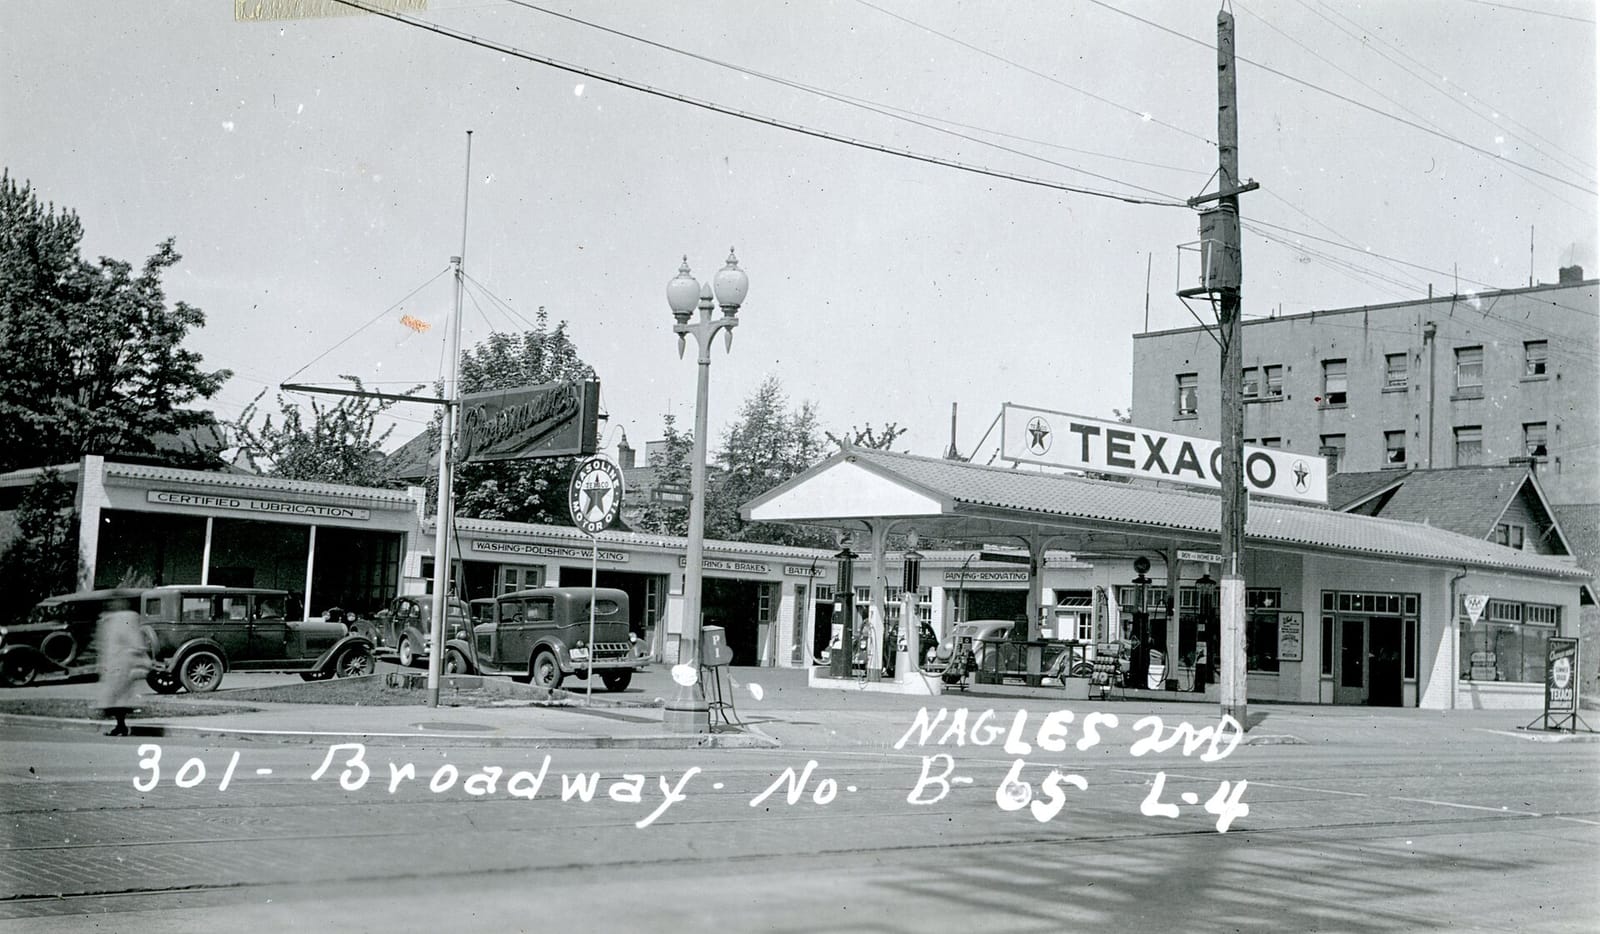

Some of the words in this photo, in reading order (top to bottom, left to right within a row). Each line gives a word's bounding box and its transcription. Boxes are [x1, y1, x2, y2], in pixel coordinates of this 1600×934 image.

[575, 460, 620, 489] GASOLINE
[157, 493, 241, 508] CERTIFIED
[250, 501, 354, 517] LUBRICATION
[572, 501, 603, 532] MOTOR
[605, 500, 619, 523] OIL
[681, 558, 723, 569] RIRING
[734, 562, 766, 572] BRAKES
[1550, 688, 1573, 700] TEXACO
